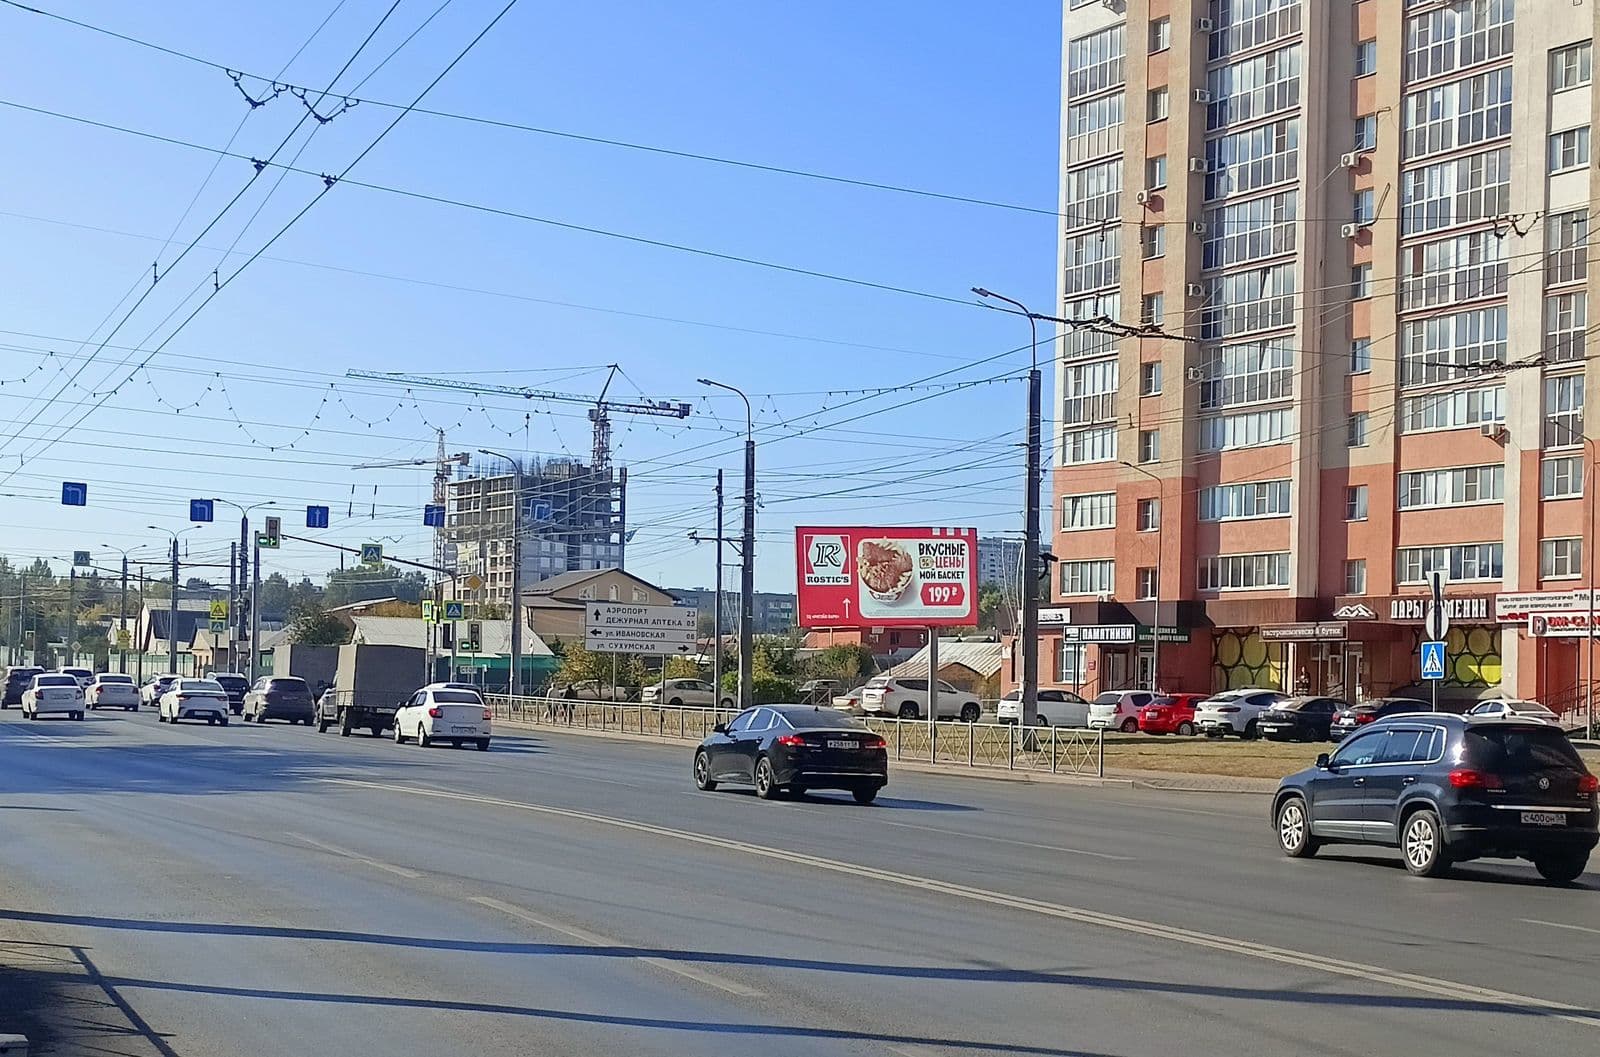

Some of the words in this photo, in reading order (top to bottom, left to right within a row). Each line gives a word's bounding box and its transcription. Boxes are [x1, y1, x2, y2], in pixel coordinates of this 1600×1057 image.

[918, 543, 965, 556] ВКУСНЫЕ
[935, 556, 965, 568] ЦЕНЫ
[919, 568, 936, 579] МОЙ
[937, 571, 965, 579] БАСКЕТ
[606, 607, 648, 615] АЭРОПОРТ
[1391, 600, 1424, 618] ДАРЫ
[606, 617, 649, 625] ДЕЖУРНАЯ
[615, 630, 665, 639] ИВАНОВСКАЯ
[1082, 627, 1132, 640] ПАМЯТНИКИ
[608, 642, 656, 650] СУХУМСКАЯ
